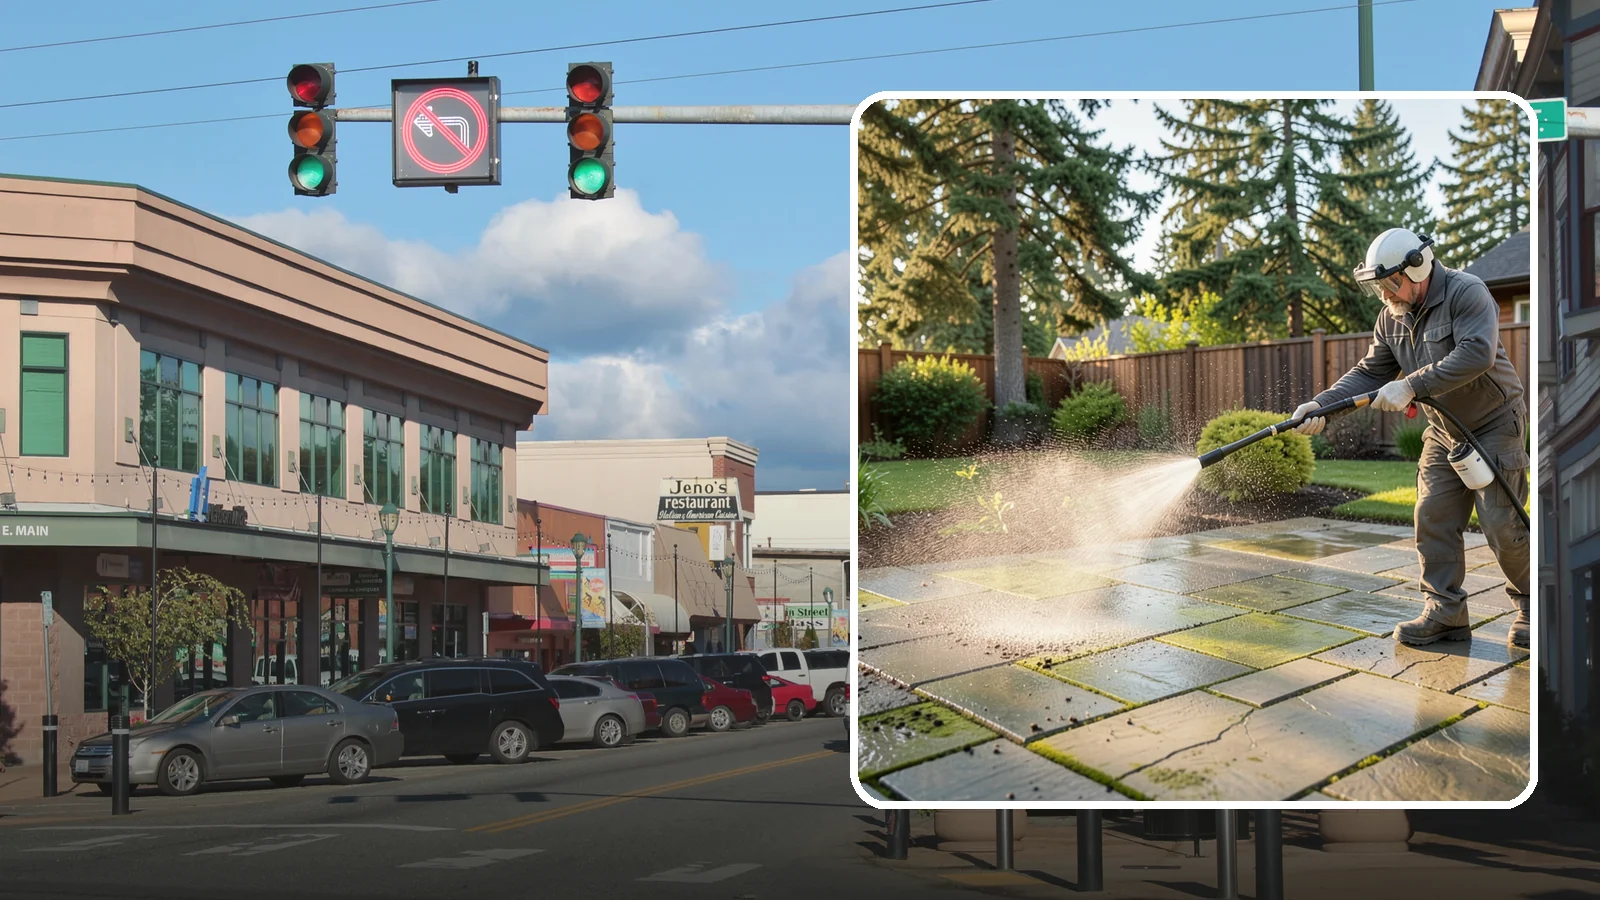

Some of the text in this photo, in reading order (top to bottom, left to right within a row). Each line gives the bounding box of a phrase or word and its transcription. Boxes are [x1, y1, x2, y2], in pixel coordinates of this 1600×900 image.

[670, 480, 728, 494] Jeno's
[665, 496, 731, 509] restaurant
[658, 509, 682, 520] Italian
[686, 509, 714, 519] American
[714, 509, 738, 519] Cuisine
[2, 525, 49, 536] E. MAIN
[797, 607, 828, 617] Street
[791, 619, 824, 627] lass
